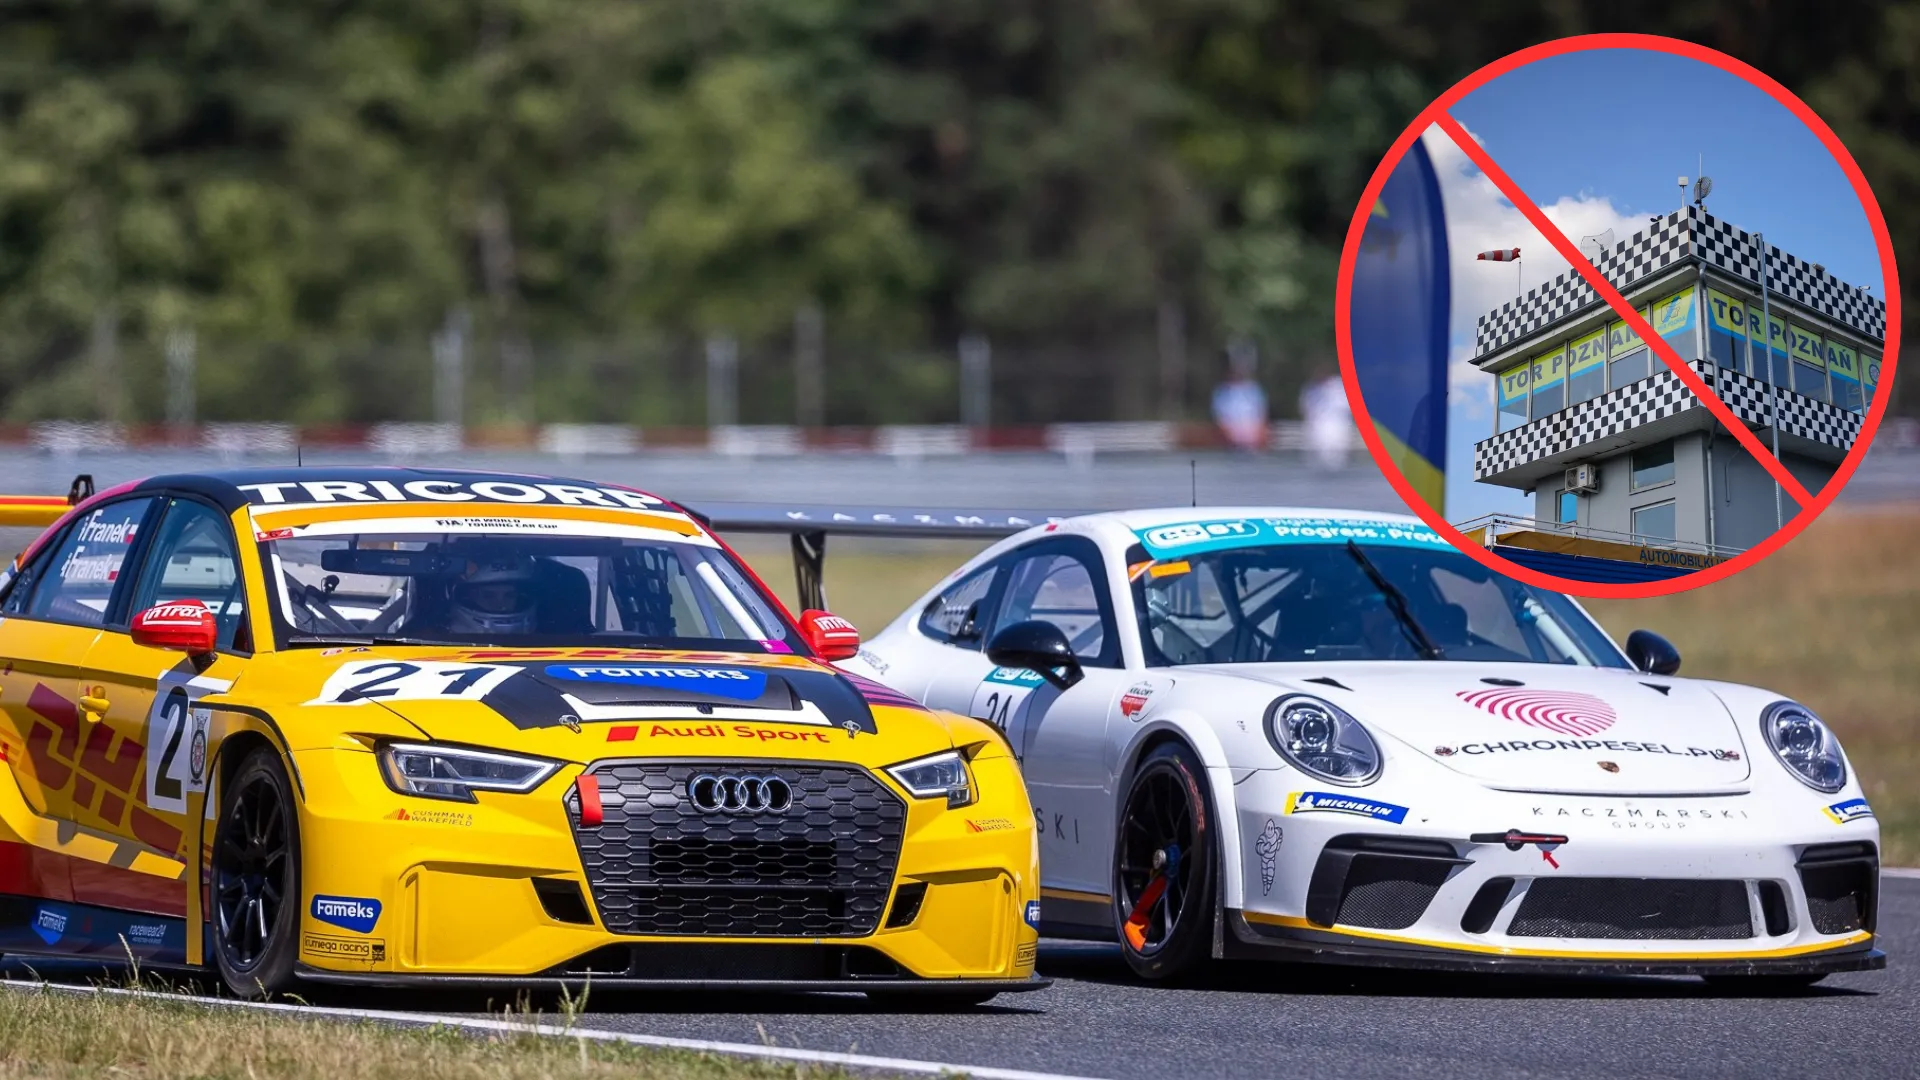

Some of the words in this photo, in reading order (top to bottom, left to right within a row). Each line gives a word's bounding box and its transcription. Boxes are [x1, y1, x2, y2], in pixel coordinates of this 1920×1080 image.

[1713, 298, 1762, 335] TOR
[1769, 322, 1852, 372] POZNAŃ
[1505, 364, 1543, 393] TOR
[237, 480, 663, 509] TRICORP
[327, 662, 497, 703] 21
[650, 725, 726, 738] Audi
[733, 726, 831, 743] Sport
[413, 810, 464, 819] CUSHMAN
[1316, 799, 1393, 816] MICHELIN
[1532, 807, 1748, 820] KACZMARSKI
[411, 816, 472, 827] WAKEFIELD
[1612, 821, 1687, 829] GROUP
[317, 899, 374, 918] Fameks
[38, 909, 68, 933] Fameks
